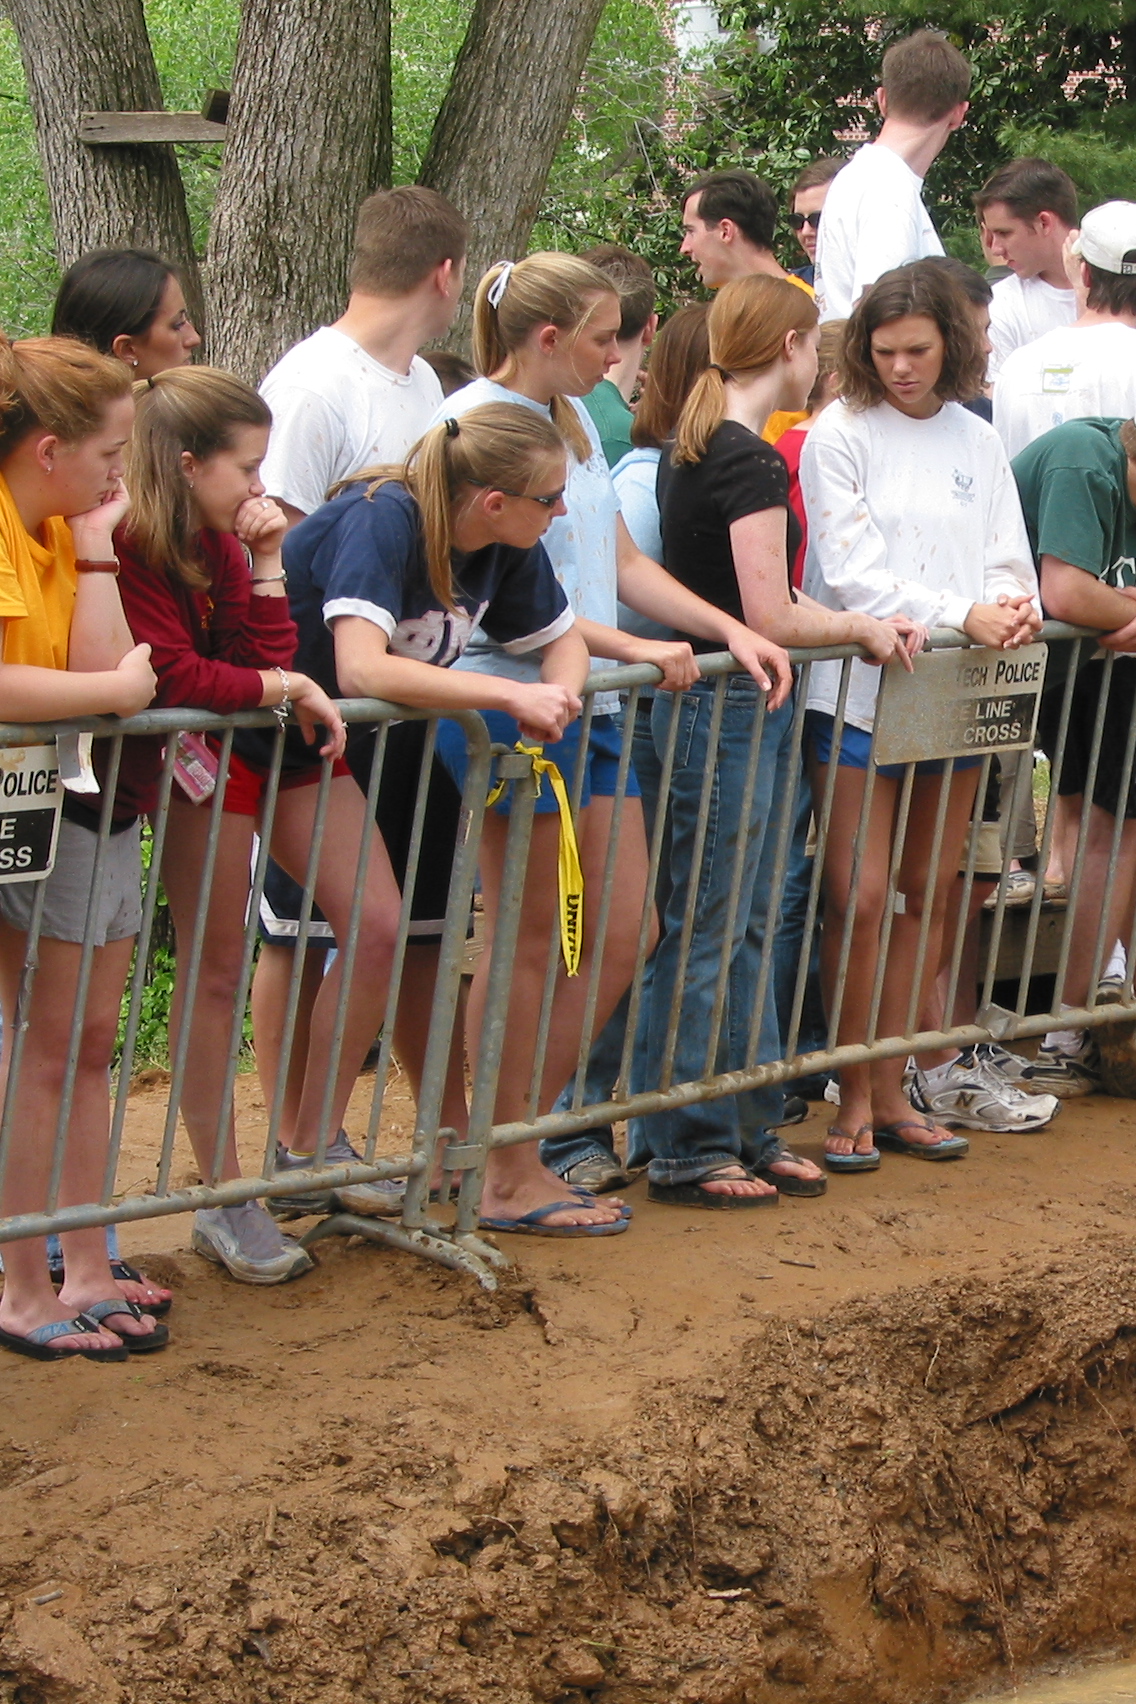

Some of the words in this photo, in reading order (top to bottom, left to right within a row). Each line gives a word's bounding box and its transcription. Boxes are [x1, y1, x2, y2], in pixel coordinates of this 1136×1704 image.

[994, 659, 1041, 685] POLICE
[975, 699, 1012, 720] LINE
[963, 722, 1022, 745] CROSS
[0, 769, 59, 799] OLICE
